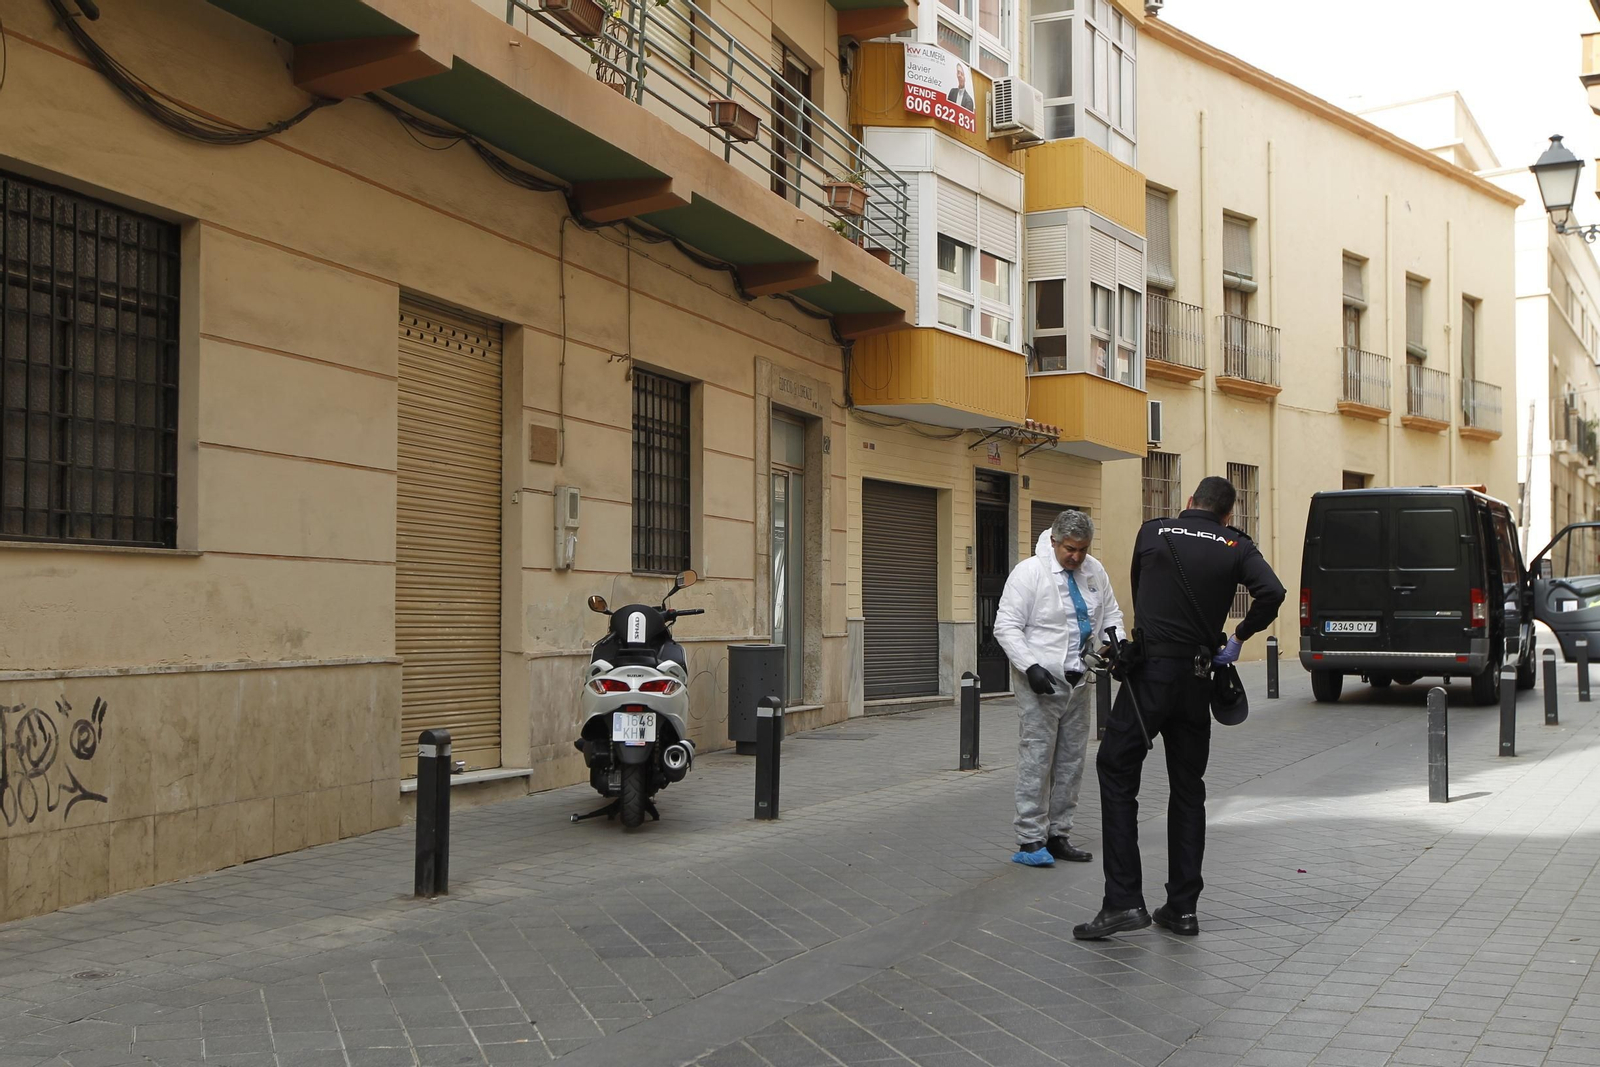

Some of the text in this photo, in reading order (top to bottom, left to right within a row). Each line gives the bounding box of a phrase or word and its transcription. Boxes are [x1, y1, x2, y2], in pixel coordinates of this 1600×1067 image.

[907, 62, 931, 74] Javier
[907, 70, 942, 87] González
[907, 85, 937, 100] VENDE
[906, 95, 976, 132] 606 622 831
[1158, 527, 1227, 545] POLICIA
[1332, 623, 1374, 631] 2349 CYZ
[627, 714, 654, 727] 1648
[623, 727, 646, 740] KHW
